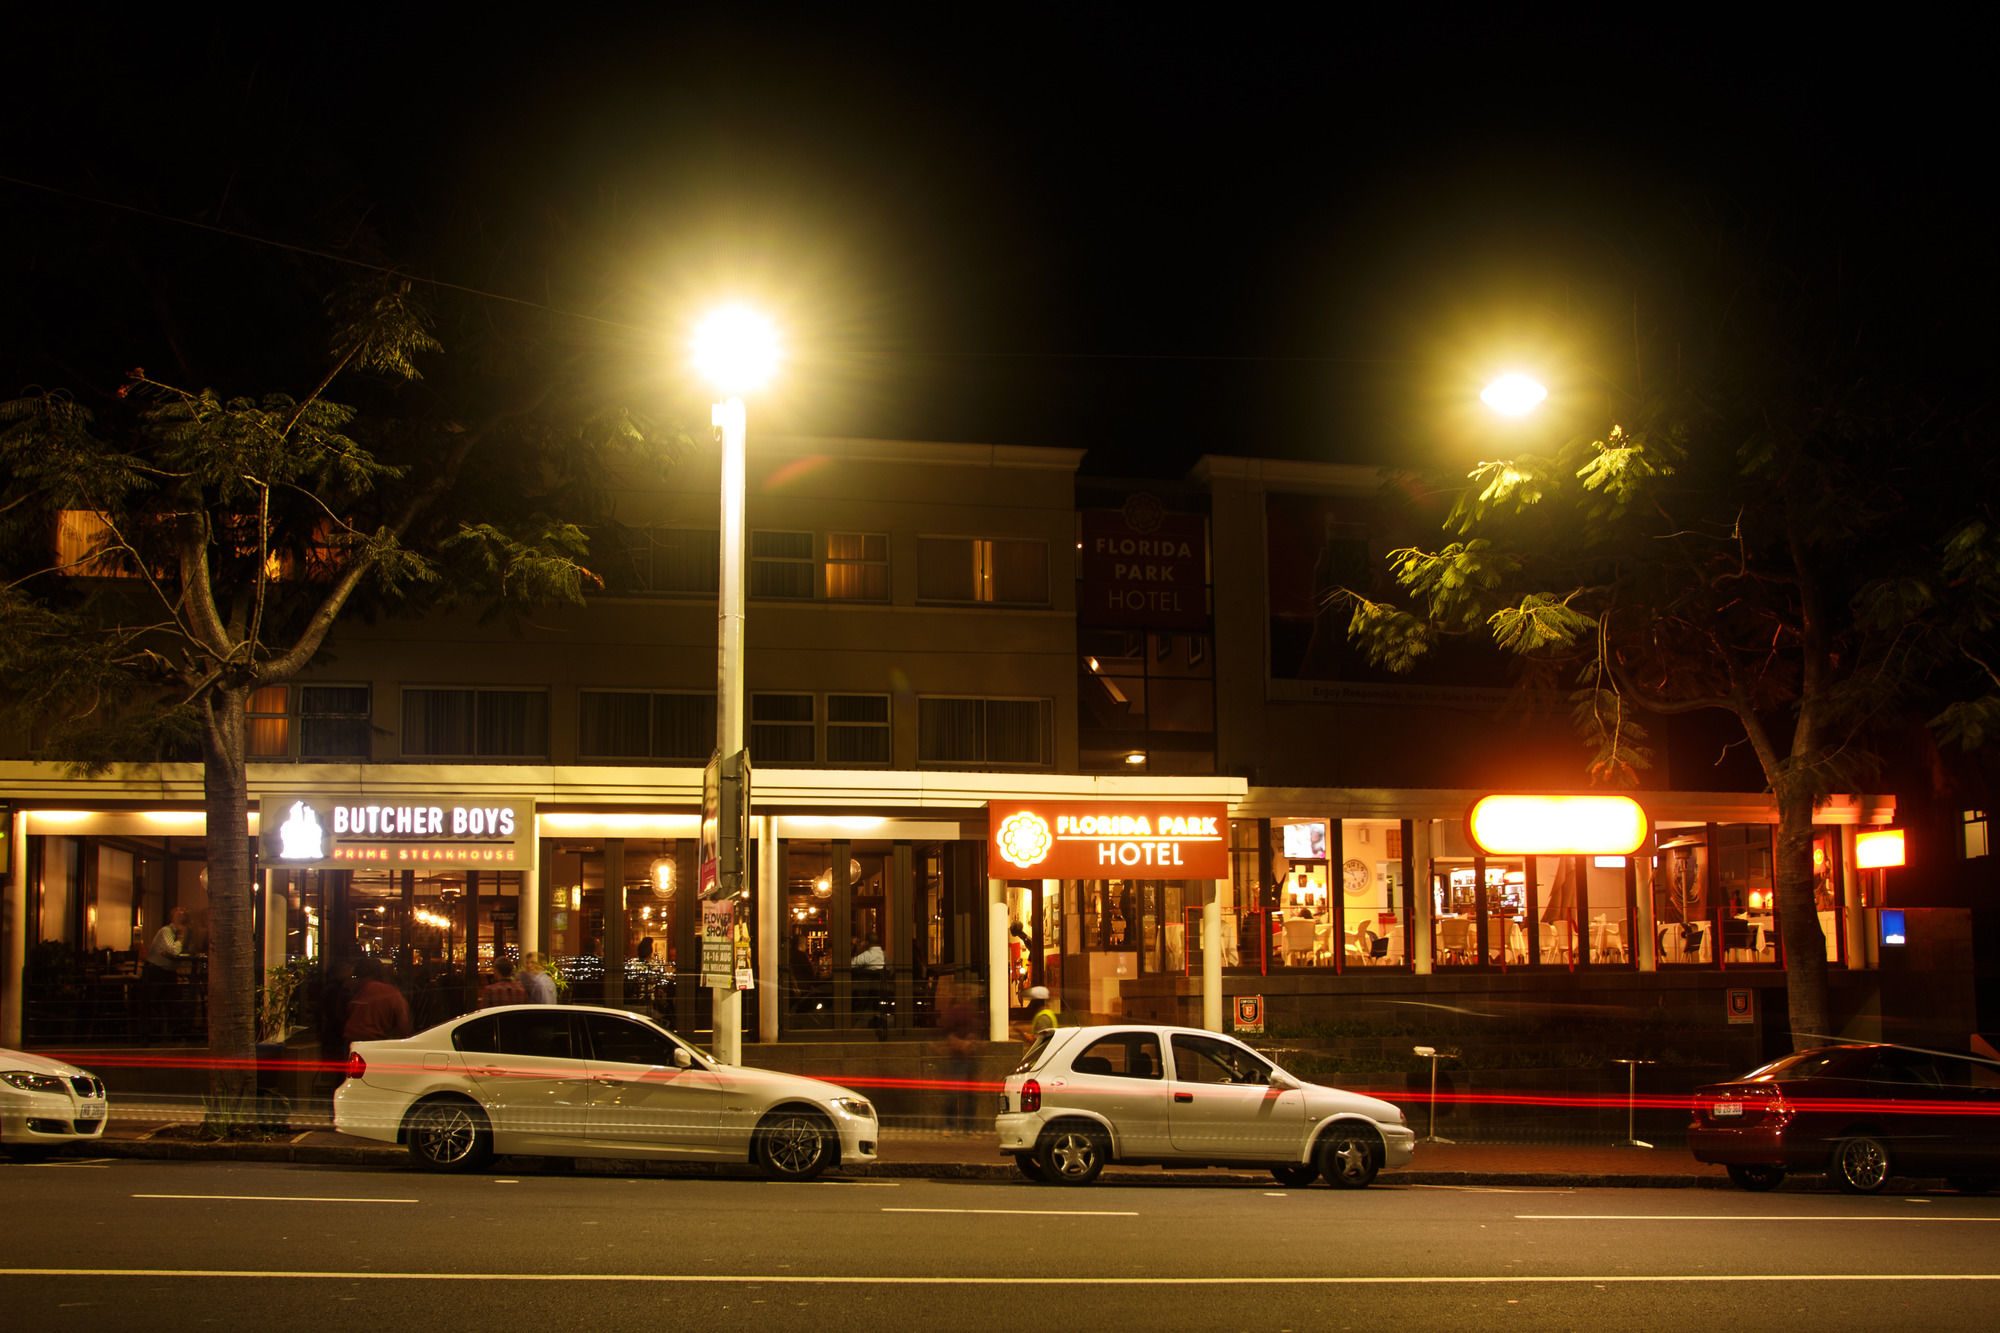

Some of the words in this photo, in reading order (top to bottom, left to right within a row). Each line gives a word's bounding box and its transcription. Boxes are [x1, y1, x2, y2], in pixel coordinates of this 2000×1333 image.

[1096, 538, 1192, 558] FLORIDA
[1115, 563, 1175, 581] PARK
[1108, 590, 1184, 612] HOTEL
[334, 806, 442, 834] BUTCHER
[453, 808, 514, 835] BOYS
[1057, 816, 1151, 835] FLORIDA
[1158, 817, 1218, 835] PARK
[334, 848, 388, 860] PRIME
[400, 849, 516, 861] STEAKHOUSE
[1099, 843, 1183, 865] HOTEL
[704, 913, 731, 924] FLOWER
[707, 926, 728, 937] SHOW
[720, 952, 731, 961] AUG
